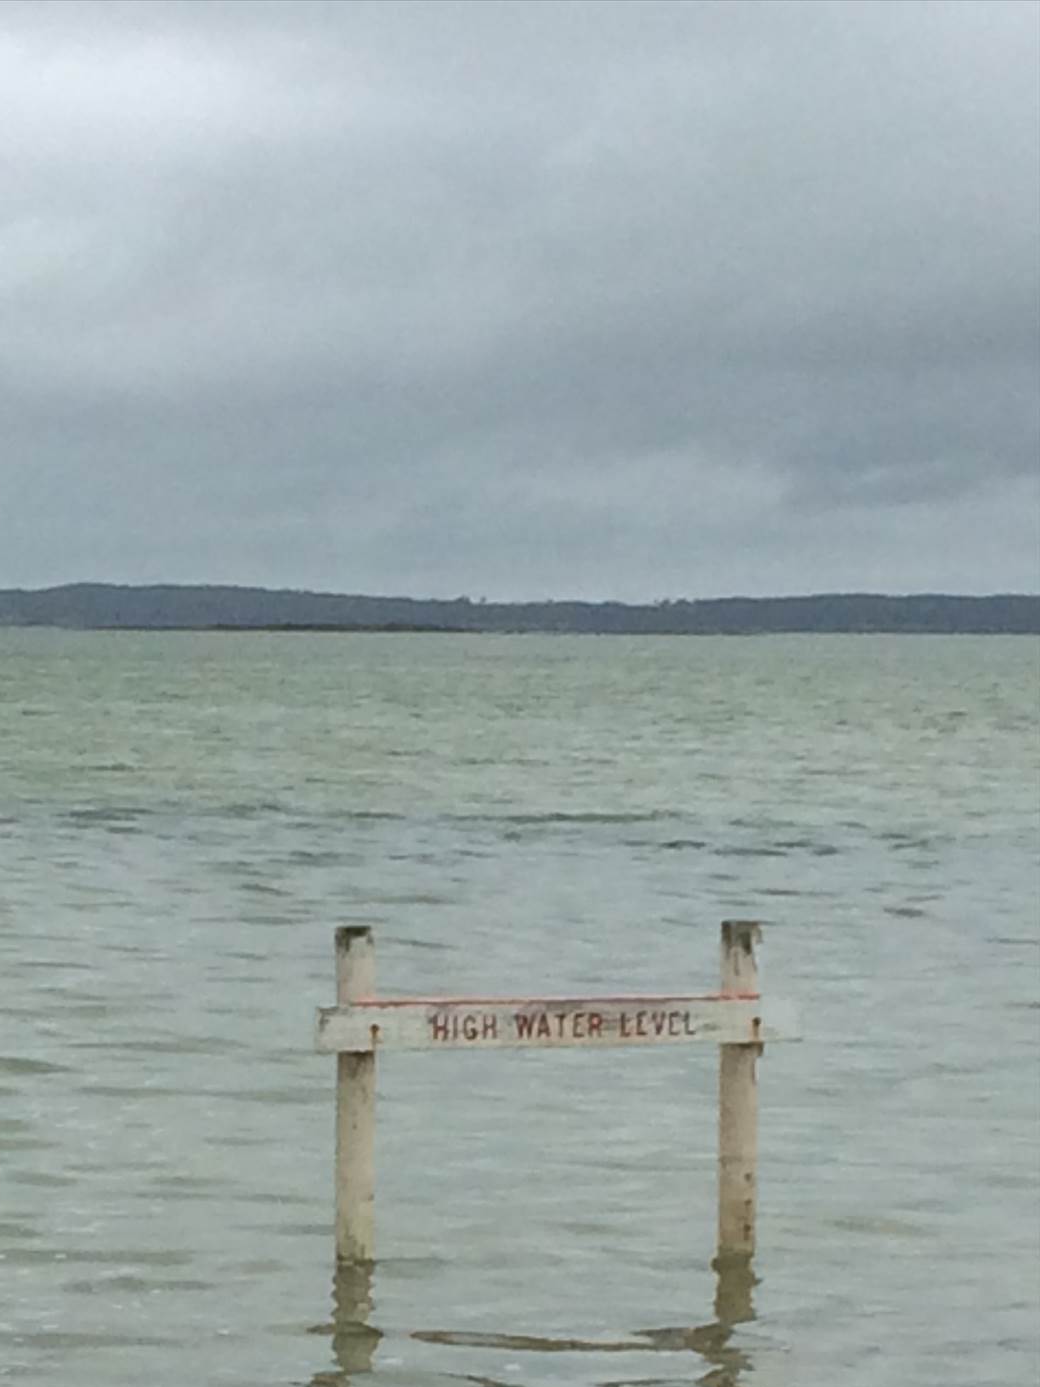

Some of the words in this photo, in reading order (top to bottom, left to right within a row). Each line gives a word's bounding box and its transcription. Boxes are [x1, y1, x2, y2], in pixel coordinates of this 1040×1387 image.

[430, 1013, 498, 1041] HIGH
[514, 1012, 603, 1039] WATER
[620, 1010, 697, 1038] LEVEL
